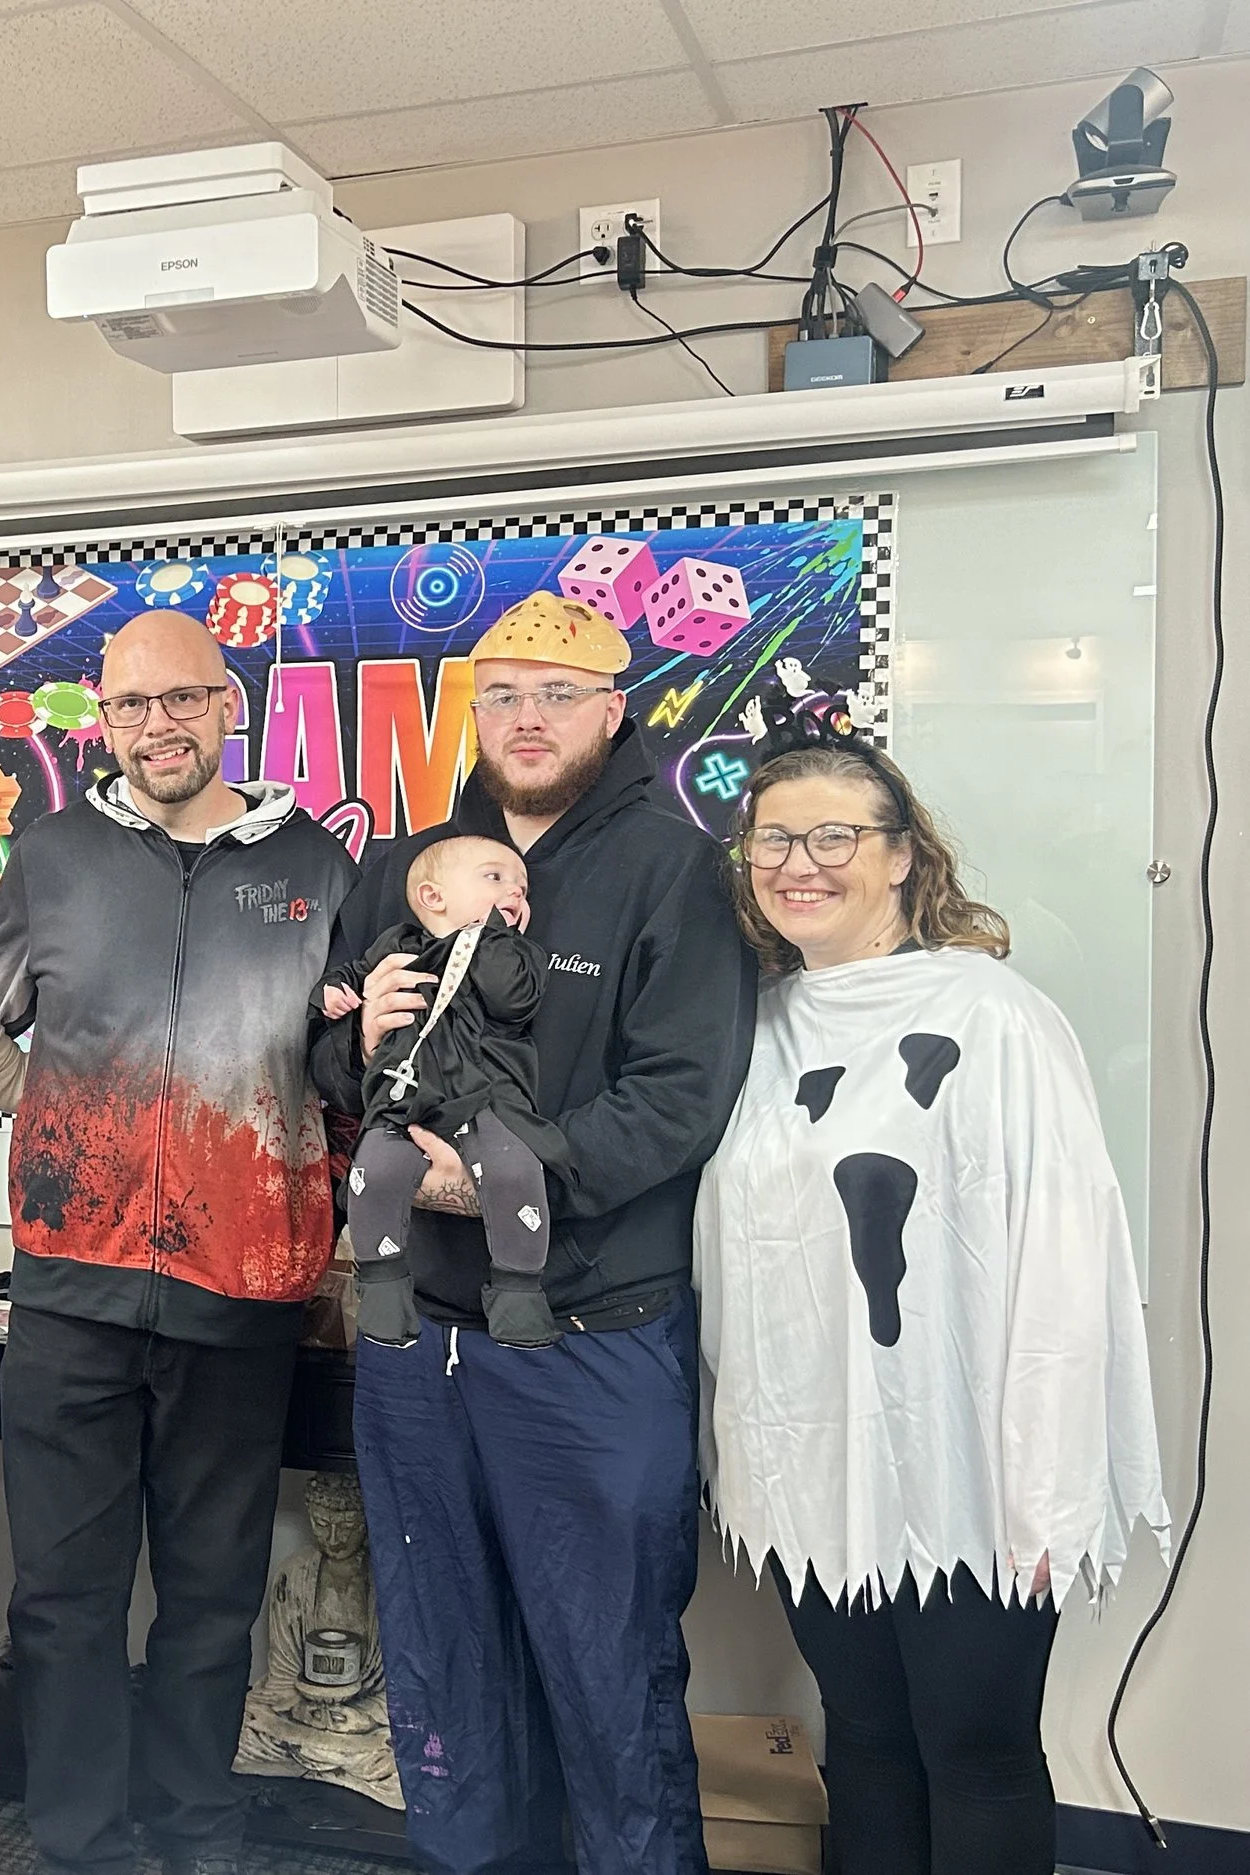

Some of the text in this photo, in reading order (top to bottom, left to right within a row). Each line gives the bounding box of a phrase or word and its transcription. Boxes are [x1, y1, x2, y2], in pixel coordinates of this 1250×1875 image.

[161, 257, 198, 271] EPSON
[221, 655, 479, 841] AM
[234, 878, 290, 913] FRIDAY
[259, 903, 288, 925] THE
[547, 952, 602, 978] Julien
